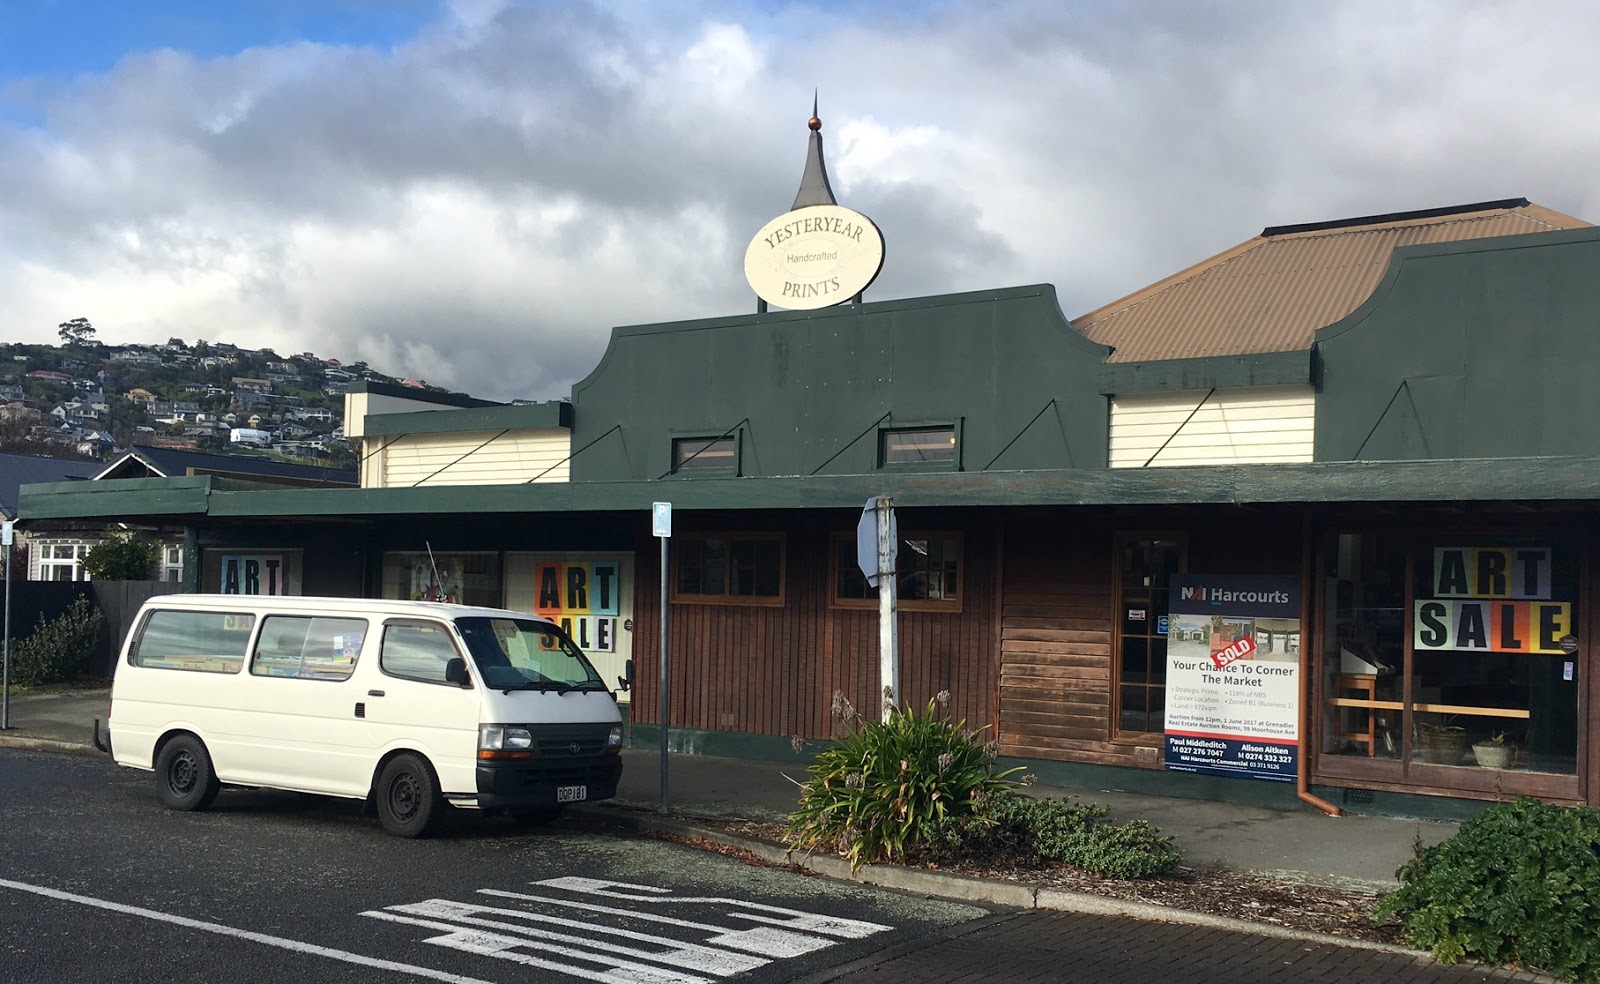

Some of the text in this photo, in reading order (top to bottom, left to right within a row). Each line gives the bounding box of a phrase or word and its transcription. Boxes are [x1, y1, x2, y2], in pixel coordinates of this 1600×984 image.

[764, 217, 863, 249] YESTERYEAR
[787, 251, 837, 263] Handcrafted
[782, 277, 840, 298] PRINTS
[225, 560, 279, 595] ART
[1438, 551, 1545, 595] ART
[540, 567, 614, 609] ART
[1181, 586, 1289, 603] NAI Harcourts
[1420, 603, 1563, 650] SALE
[1217, 639, 1250, 665] SOLD
[1173, 660, 1294, 676] Your Chance To Corner
[1202, 674, 1262, 687] The Market
[1194, 696, 1219, 704] Location
[1170, 737, 1227, 749] Paul Middleditch
[1241, 744, 1289, 755] Alison Aitken
[1206, 749, 1224, 757] 7047
[1278, 755, 1292, 763] 327
[1216, 758, 1249, 766] Commercial
[357, 876, 895, 984] STOP
